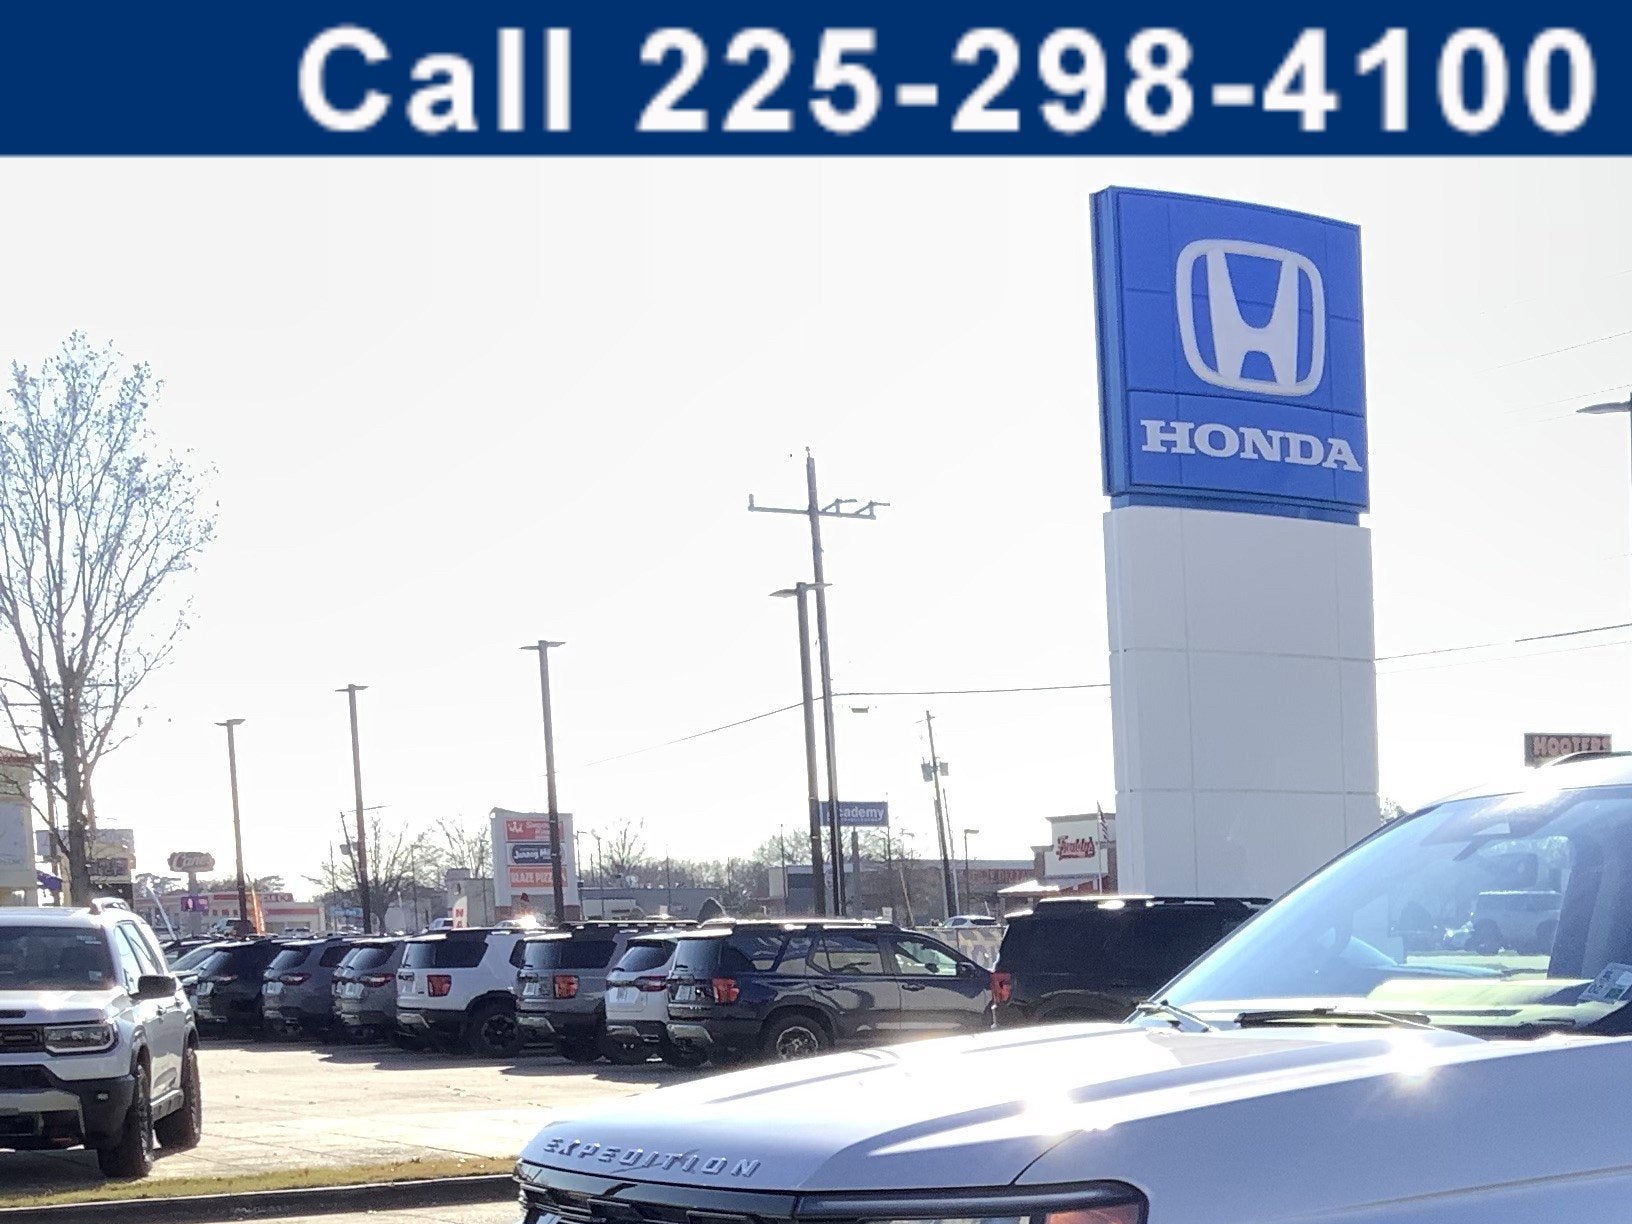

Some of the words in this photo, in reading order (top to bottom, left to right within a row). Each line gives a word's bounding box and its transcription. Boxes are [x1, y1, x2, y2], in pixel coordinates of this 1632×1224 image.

[1140, 419, 1363, 472] HONDA
[1533, 736, 1609, 757] HOOTERS
[827, 805, 884, 822] cademy
[543, 1138, 762, 1177] EXPEDITION
